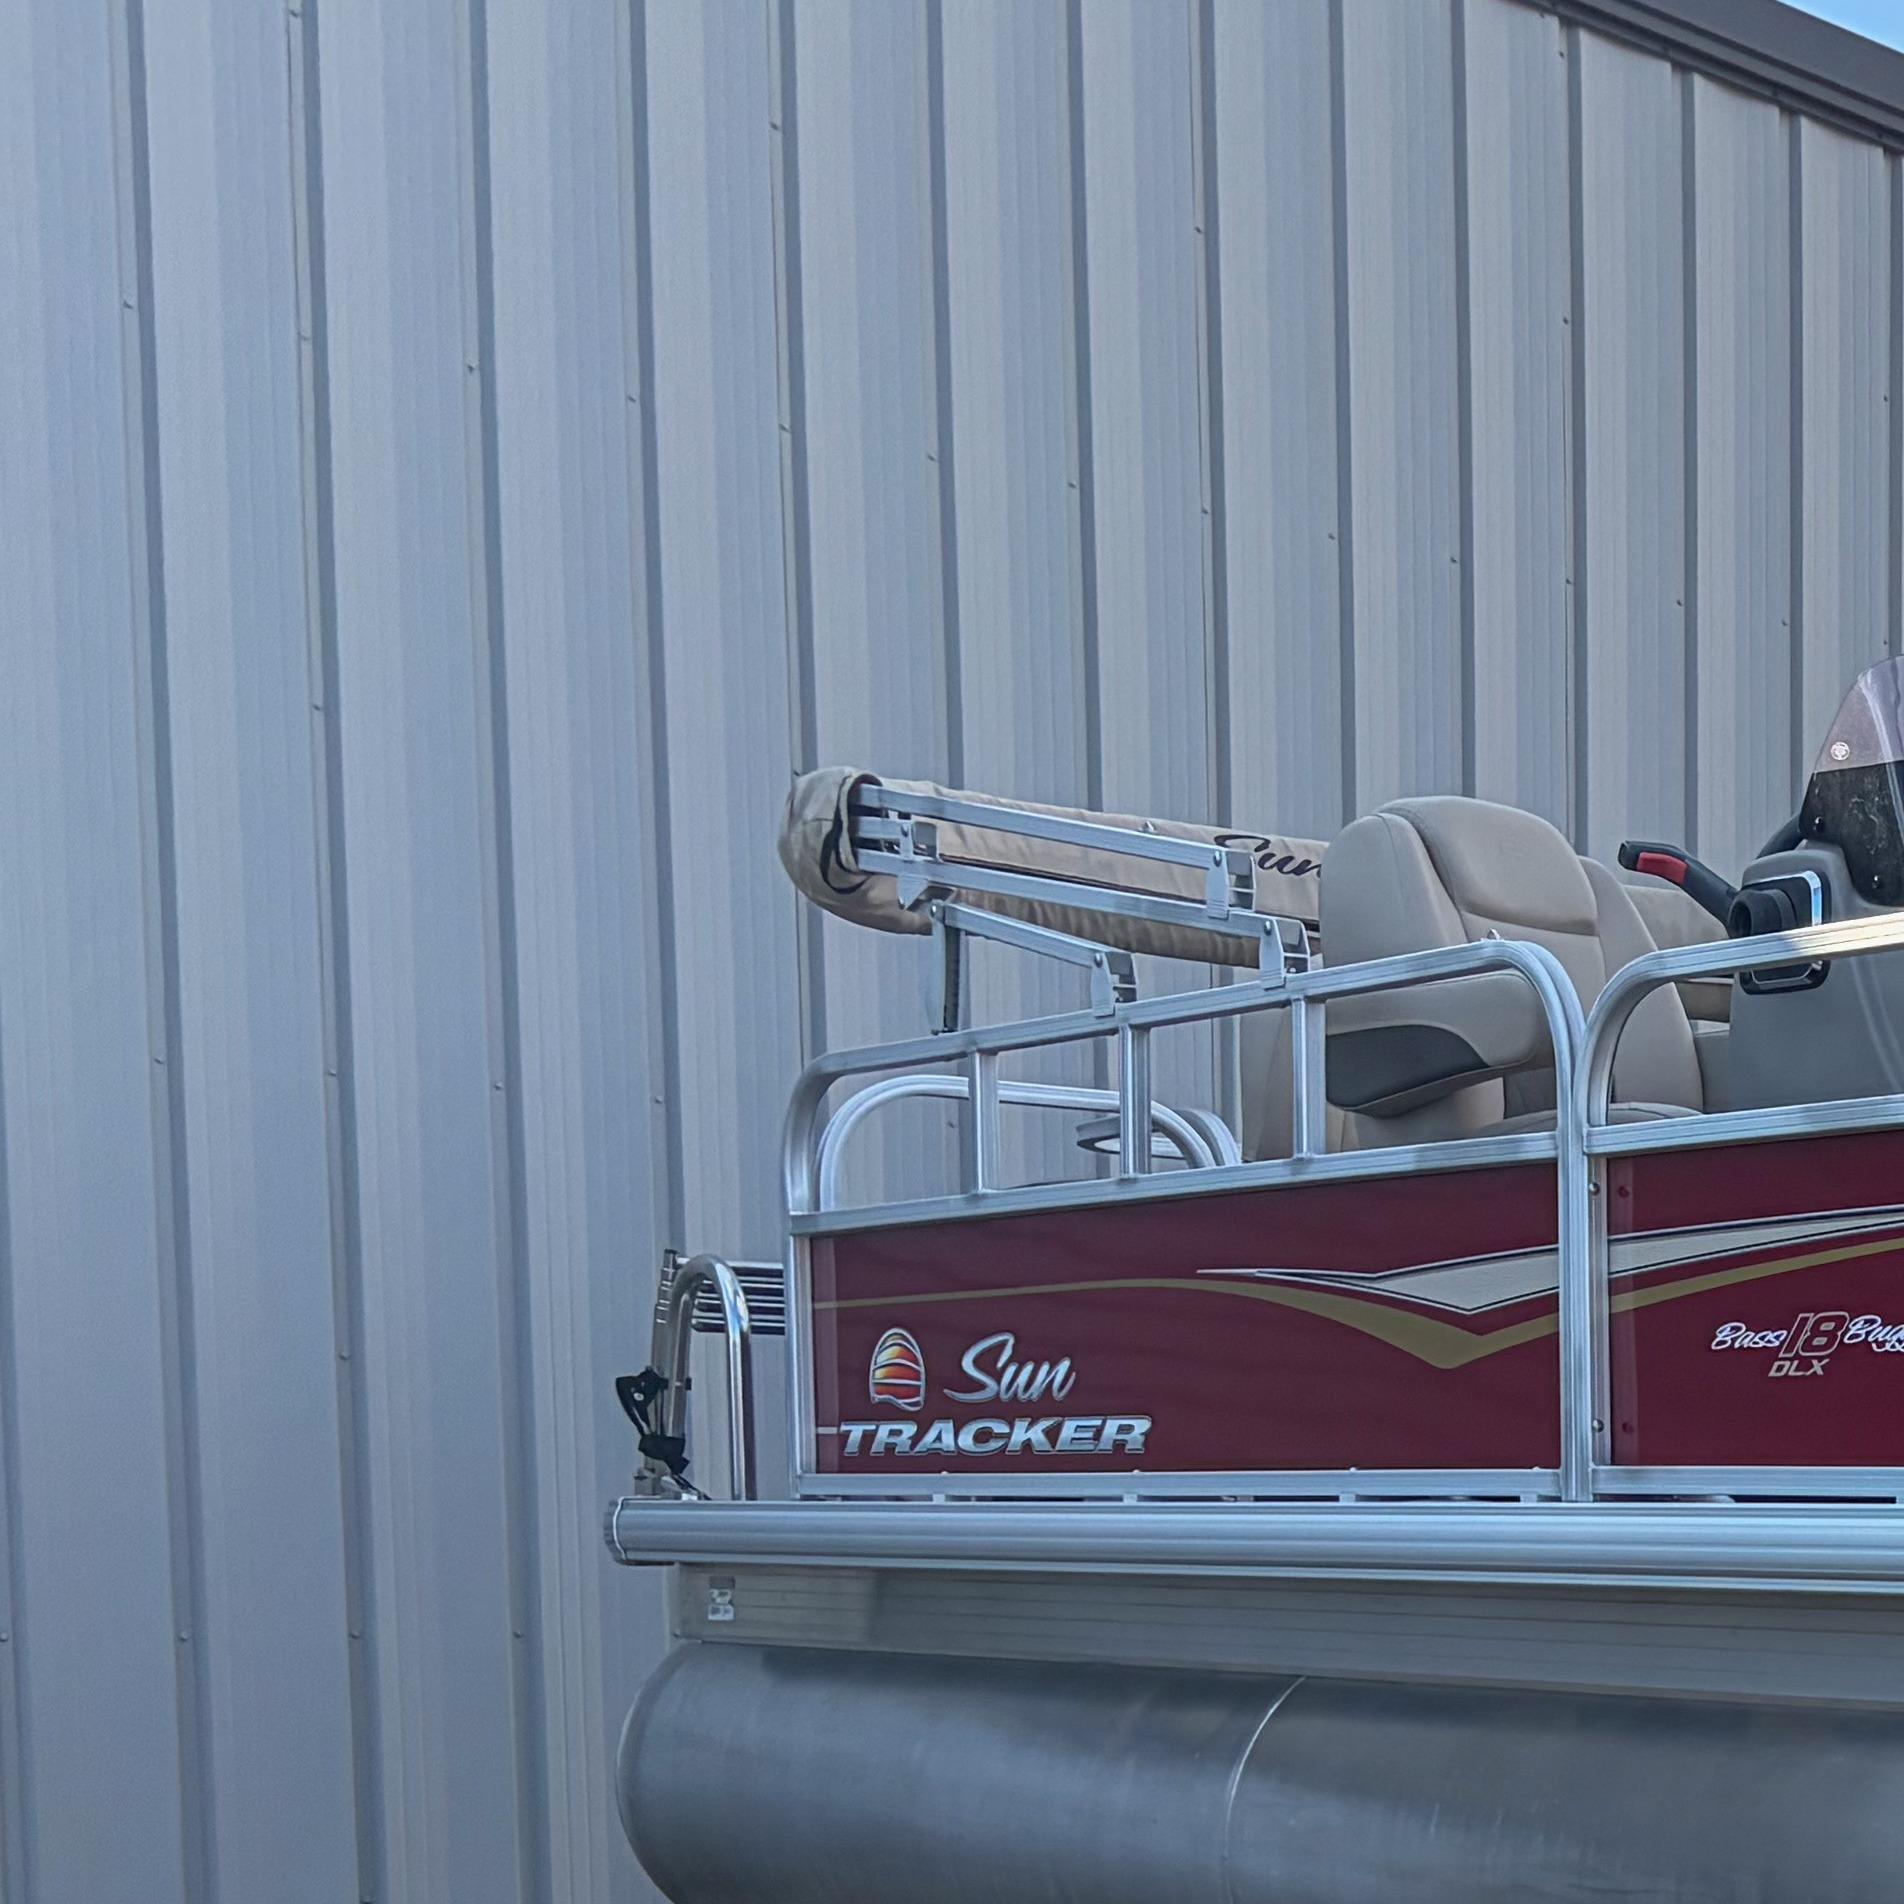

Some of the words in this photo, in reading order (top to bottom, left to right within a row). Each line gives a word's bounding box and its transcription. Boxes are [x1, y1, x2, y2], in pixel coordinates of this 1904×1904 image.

[1711, 1322, 1787, 1350] Bass
[1779, 1311, 1850, 1358] 18
[943, 1332, 1076, 1403] Sun
[1768, 1358, 1830, 1377] DLX
[839, 1415, 1152, 1456] TRACKER
